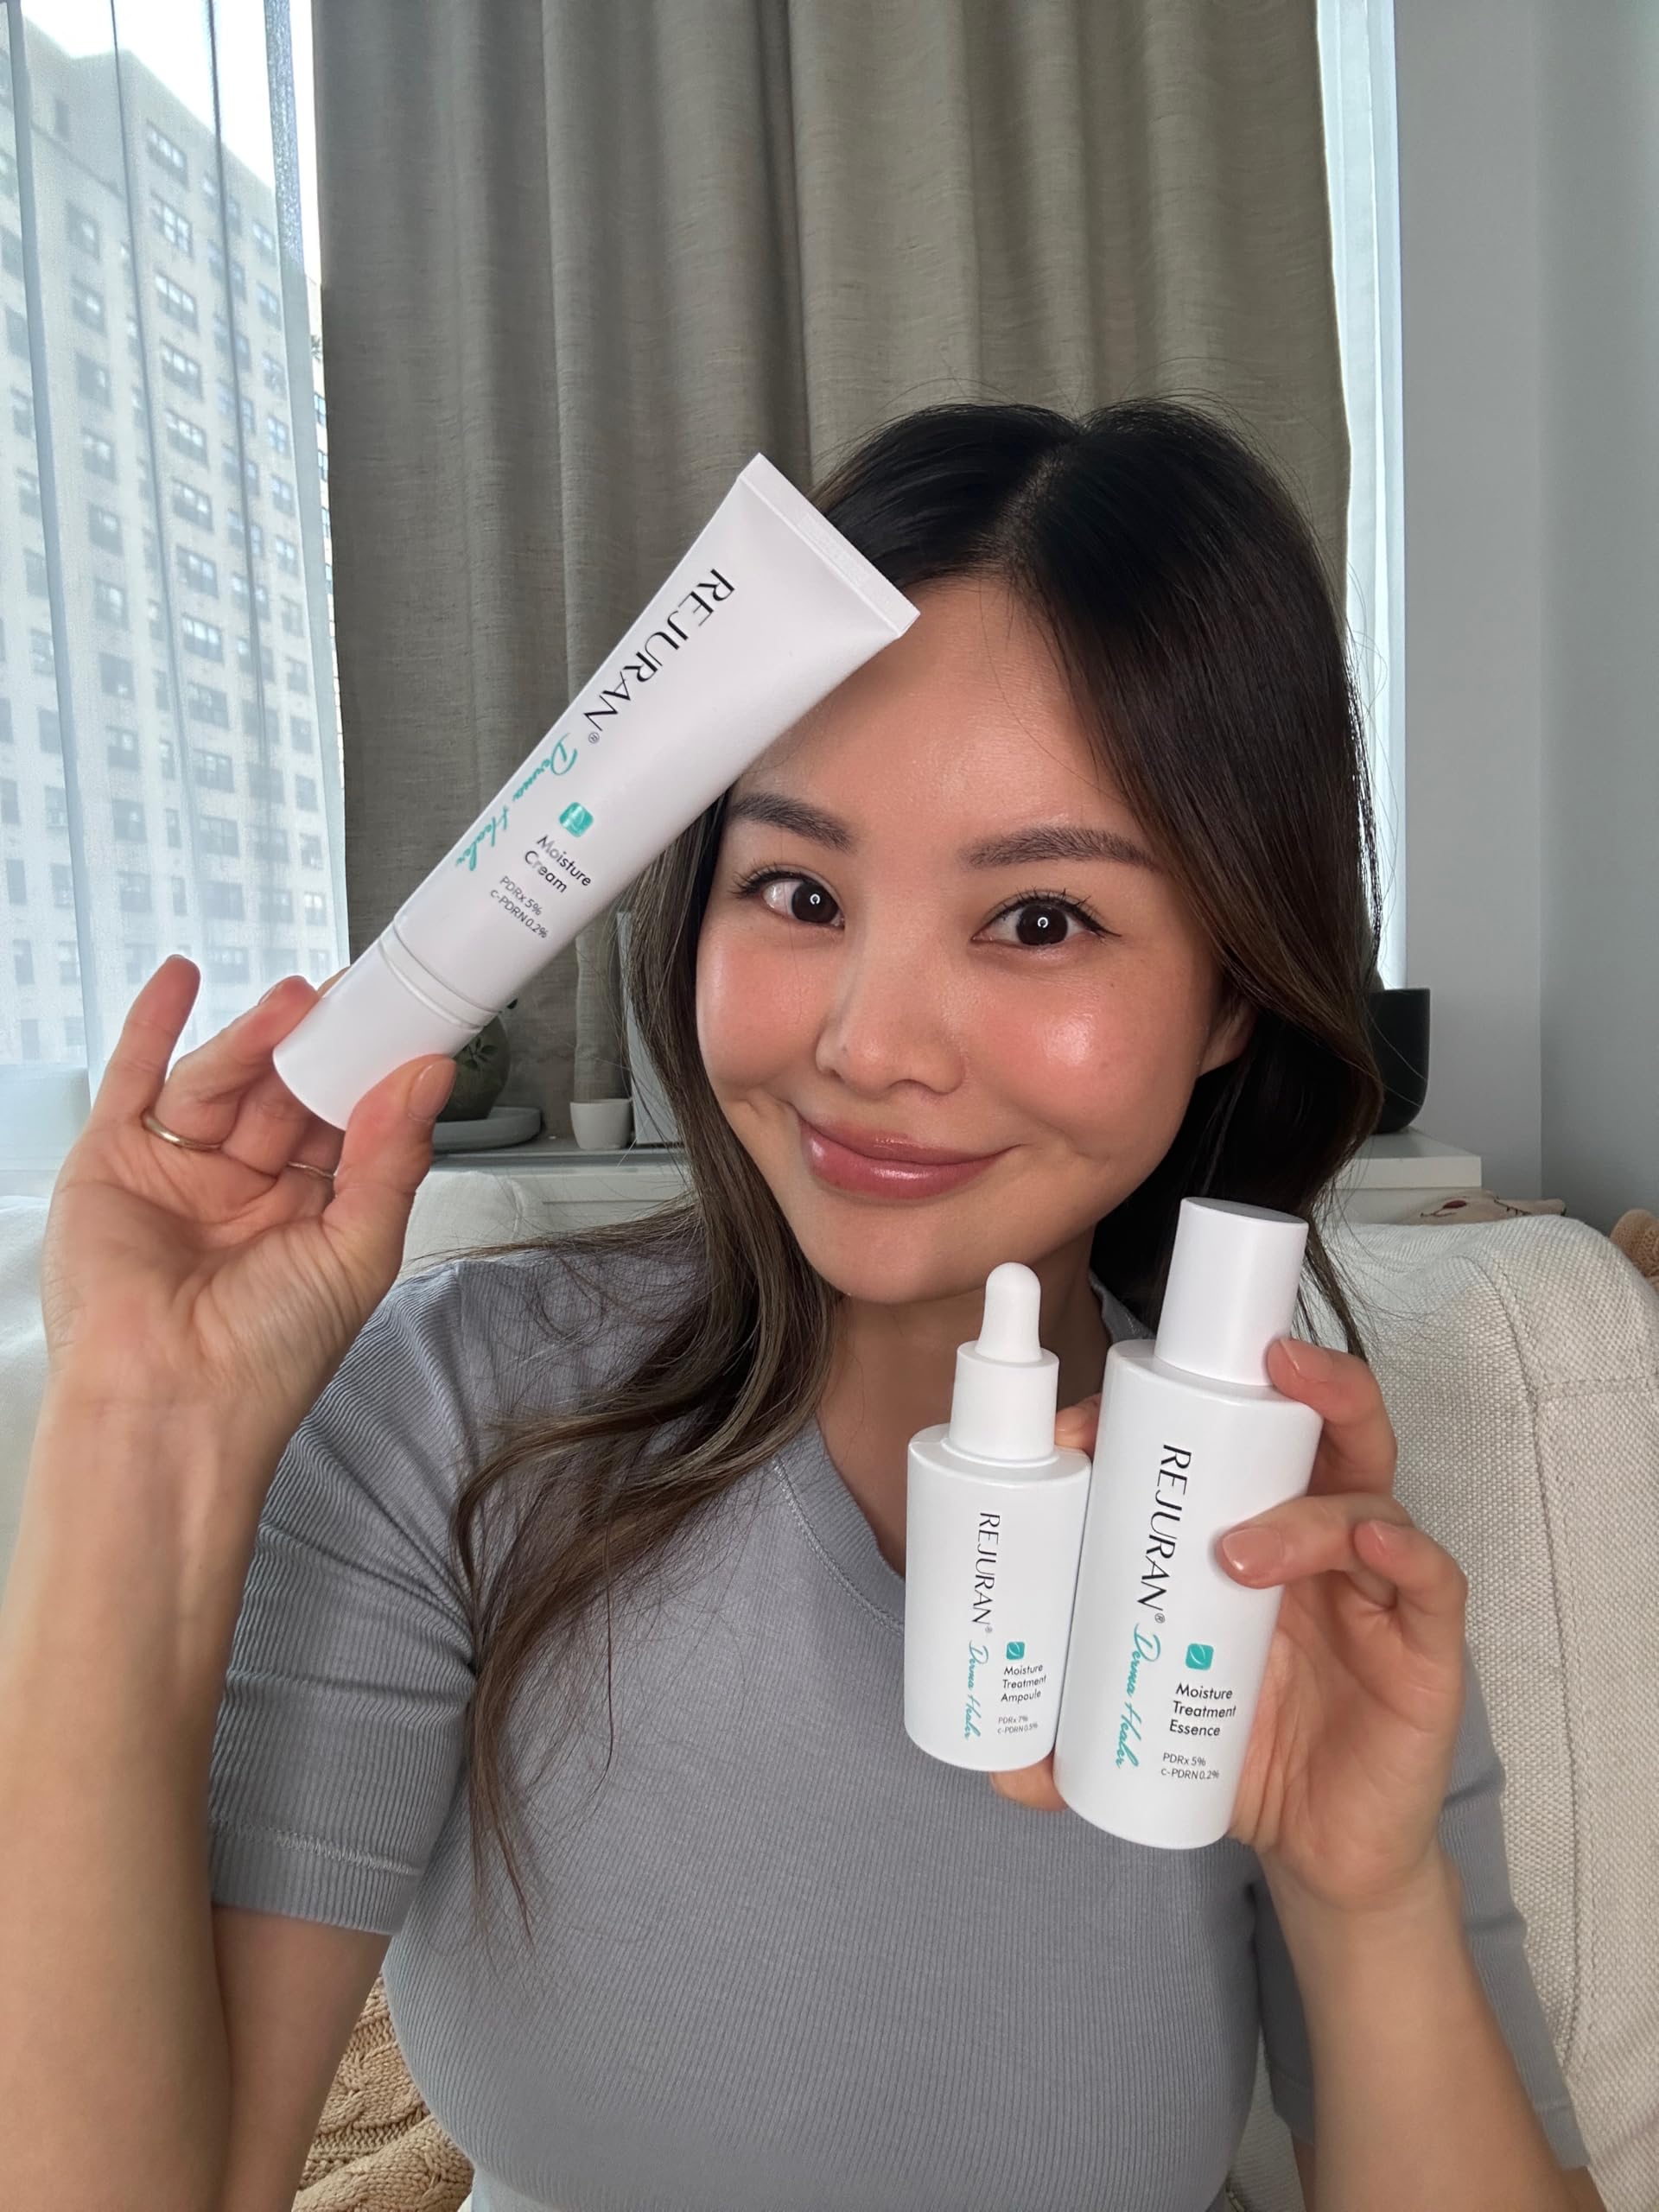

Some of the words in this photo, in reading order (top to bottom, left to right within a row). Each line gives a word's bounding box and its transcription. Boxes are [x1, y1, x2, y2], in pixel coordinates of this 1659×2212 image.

[537, 835, 591, 887] Moisture
[524, 850, 567, 893] Cream
[499, 875, 527, 903] PDRx
[524, 899, 543, 916] 5%
[968, 1640, 988, 1690] Derma
[1003, 1664, 1044, 1676] Moisture
[1127, 1623, 1161, 1698] Derma
[1002, 1675, 1046, 1689] Treatment
[1175, 1682, 1233, 1700] Moisture
[1001, 1688, 1041, 1704] Ampoule
[1173, 1700, 1236, 1719] Treatment
[1116, 1701, 1142, 1769] Healer
[1169, 1719, 1221, 1737] Essence
[1163, 1751, 1190, 1765] PDRx
[1191, 1756, 1206, 1767] 5%
